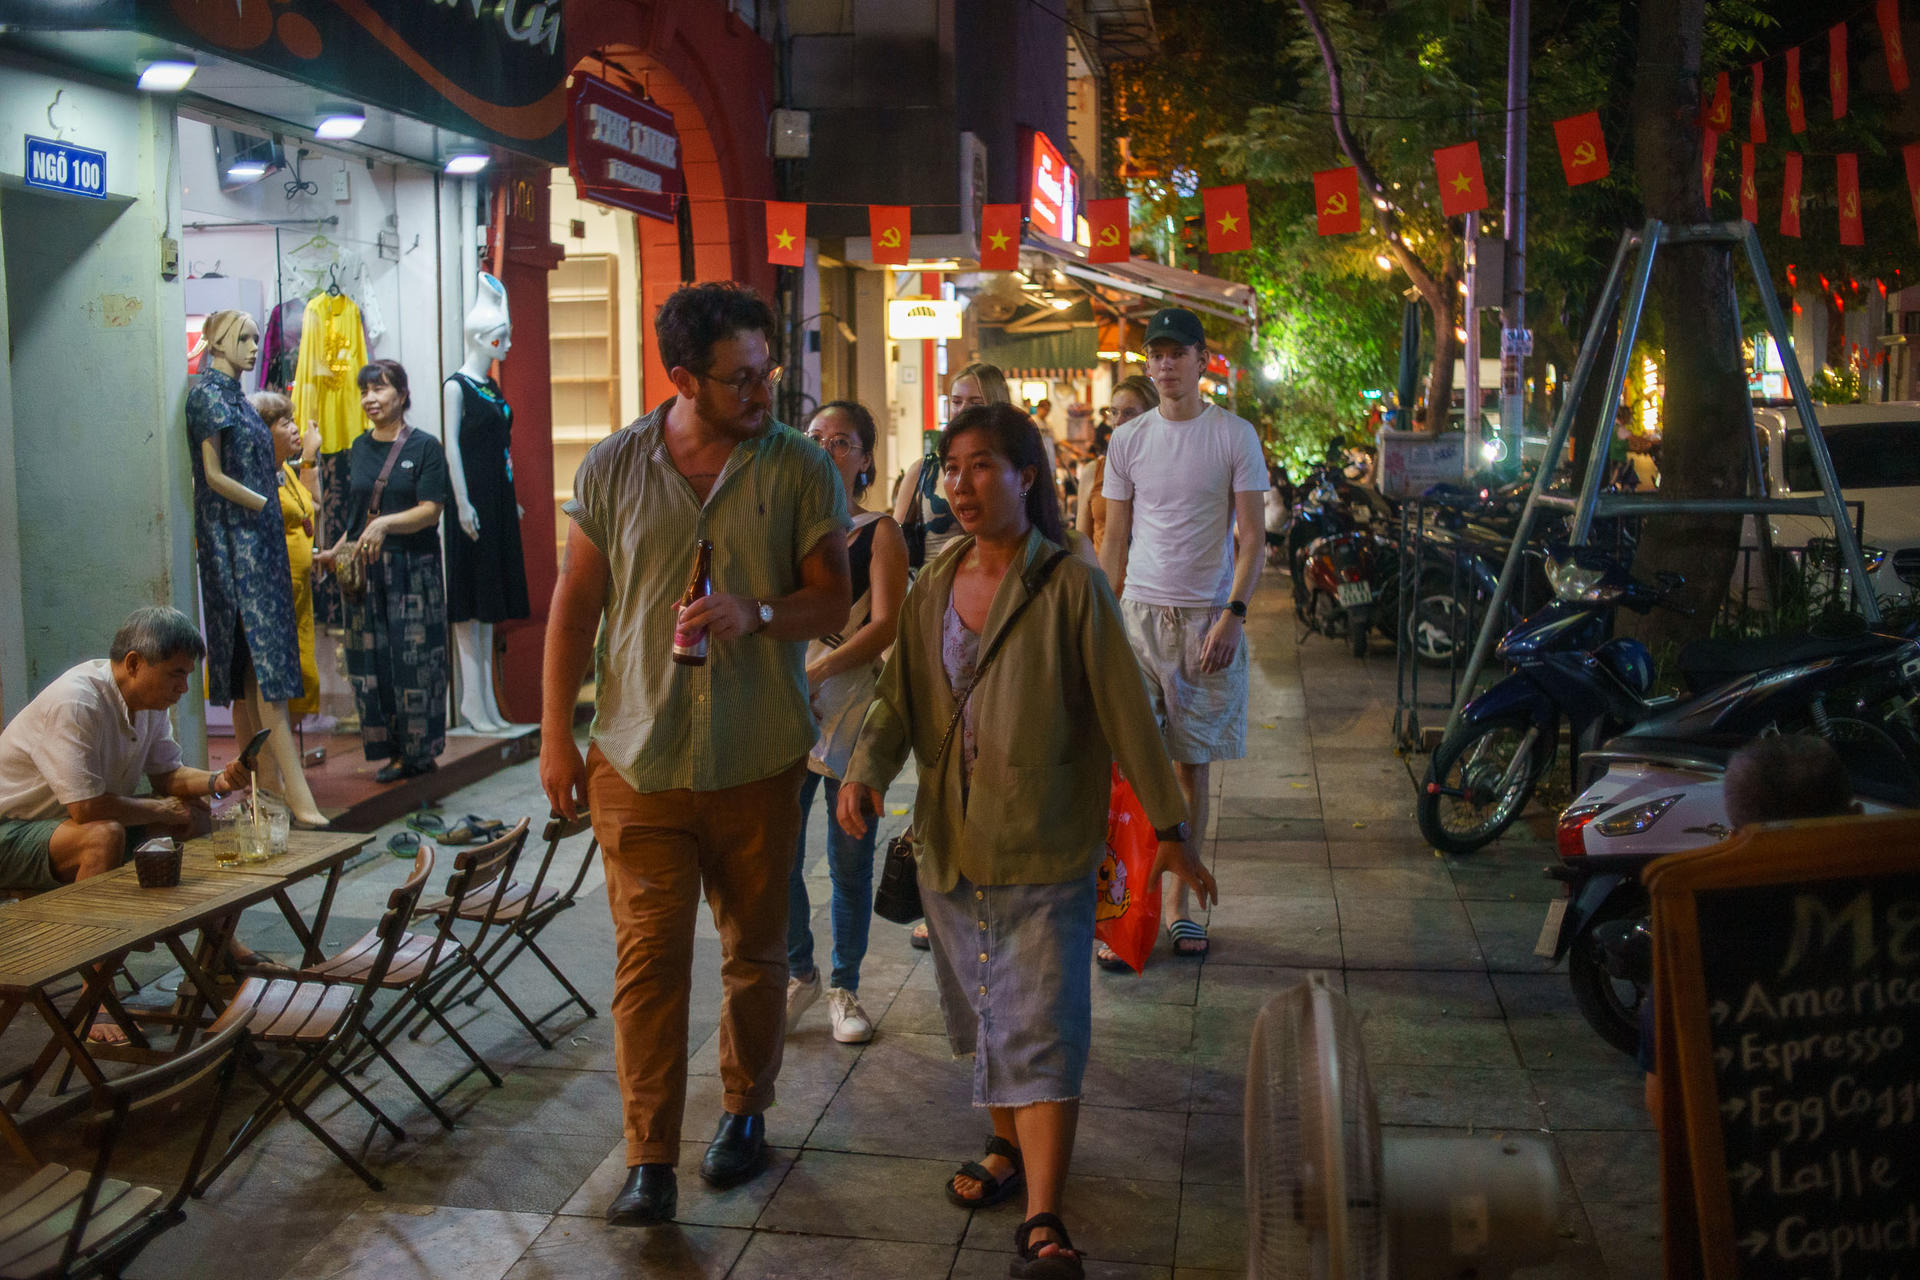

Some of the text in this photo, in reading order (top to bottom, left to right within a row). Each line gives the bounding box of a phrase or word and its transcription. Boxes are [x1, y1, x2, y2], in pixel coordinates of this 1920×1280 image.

[33, 150, 100, 190] NGÕ 100
[1740, 1025, 1904, 1082] Espresso
[1750, 1084, 1825, 1143] Egg
